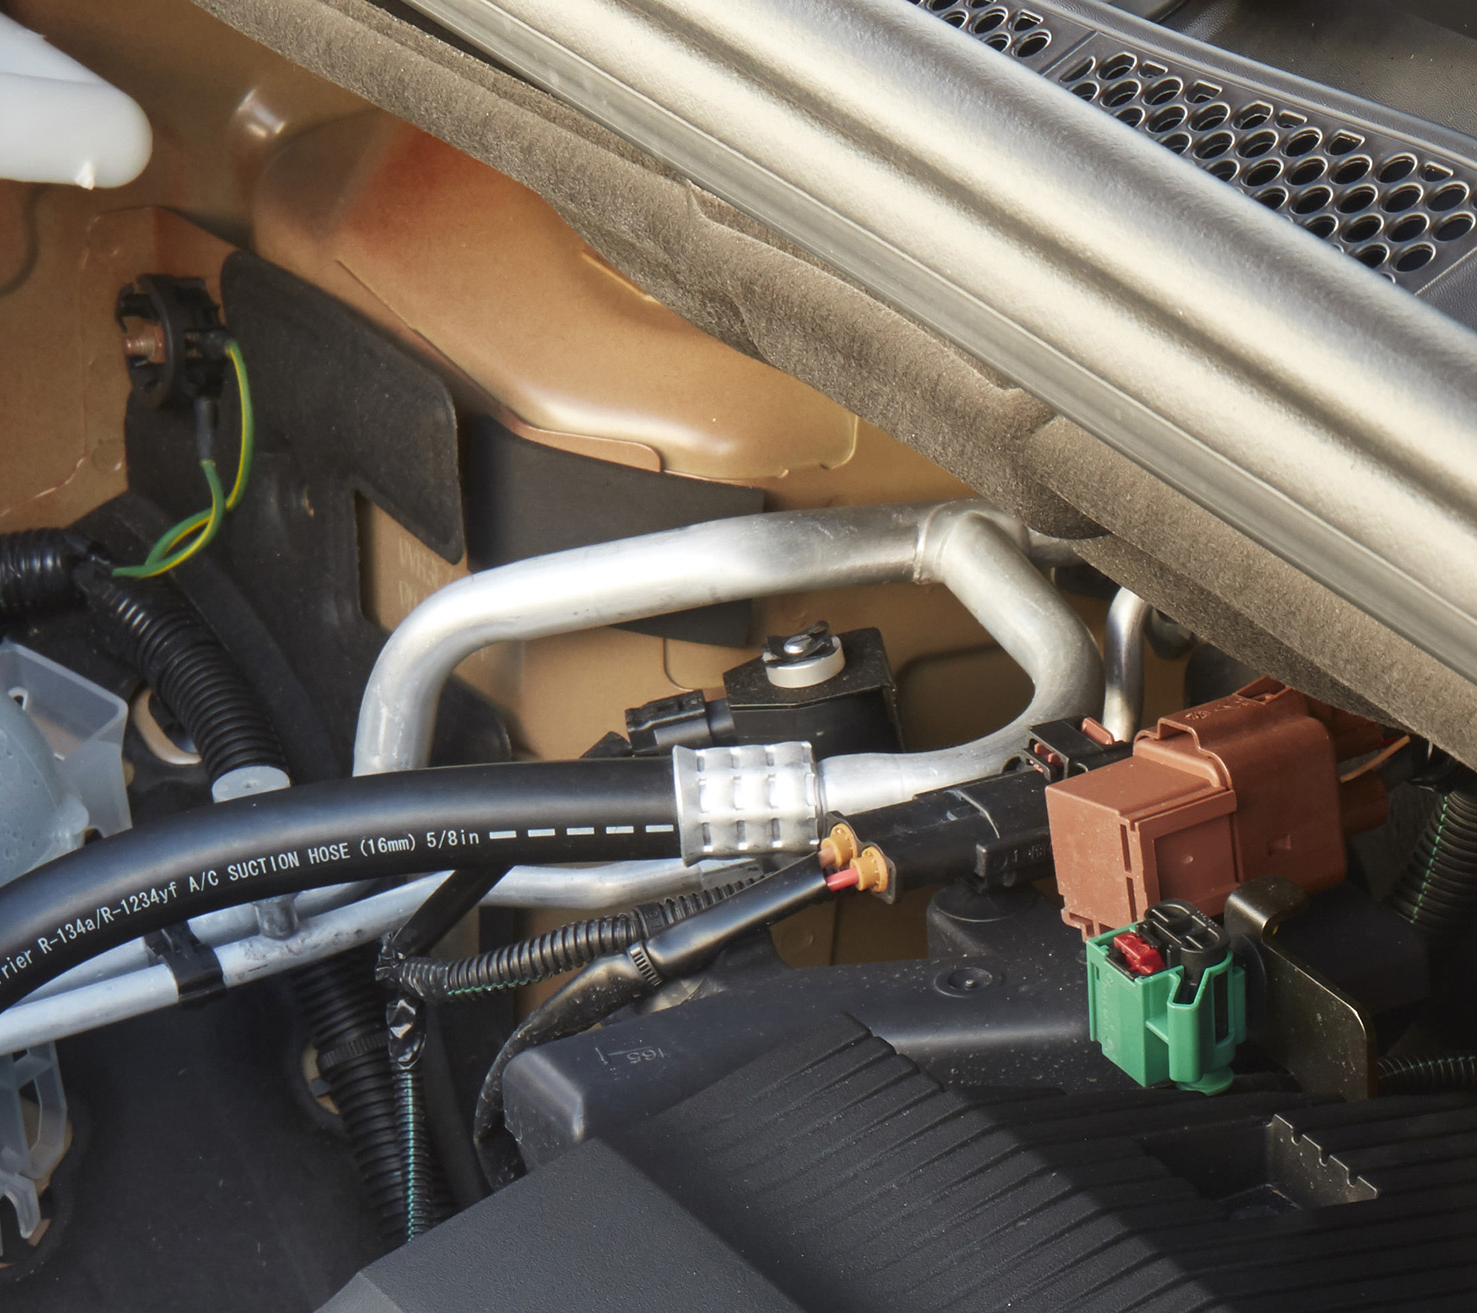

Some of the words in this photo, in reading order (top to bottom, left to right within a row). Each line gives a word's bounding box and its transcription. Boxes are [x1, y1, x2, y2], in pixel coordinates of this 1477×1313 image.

[37, 881, 178, 955] R-134a/R-1234yf
[188, 870, 219, 892] A/C
[227, 851, 300, 881] SUCTION
[308, 842, 351, 865] HOSE
[360, 833, 416, 857] (16mm)
[426, 829, 480, 849] 5/8in
